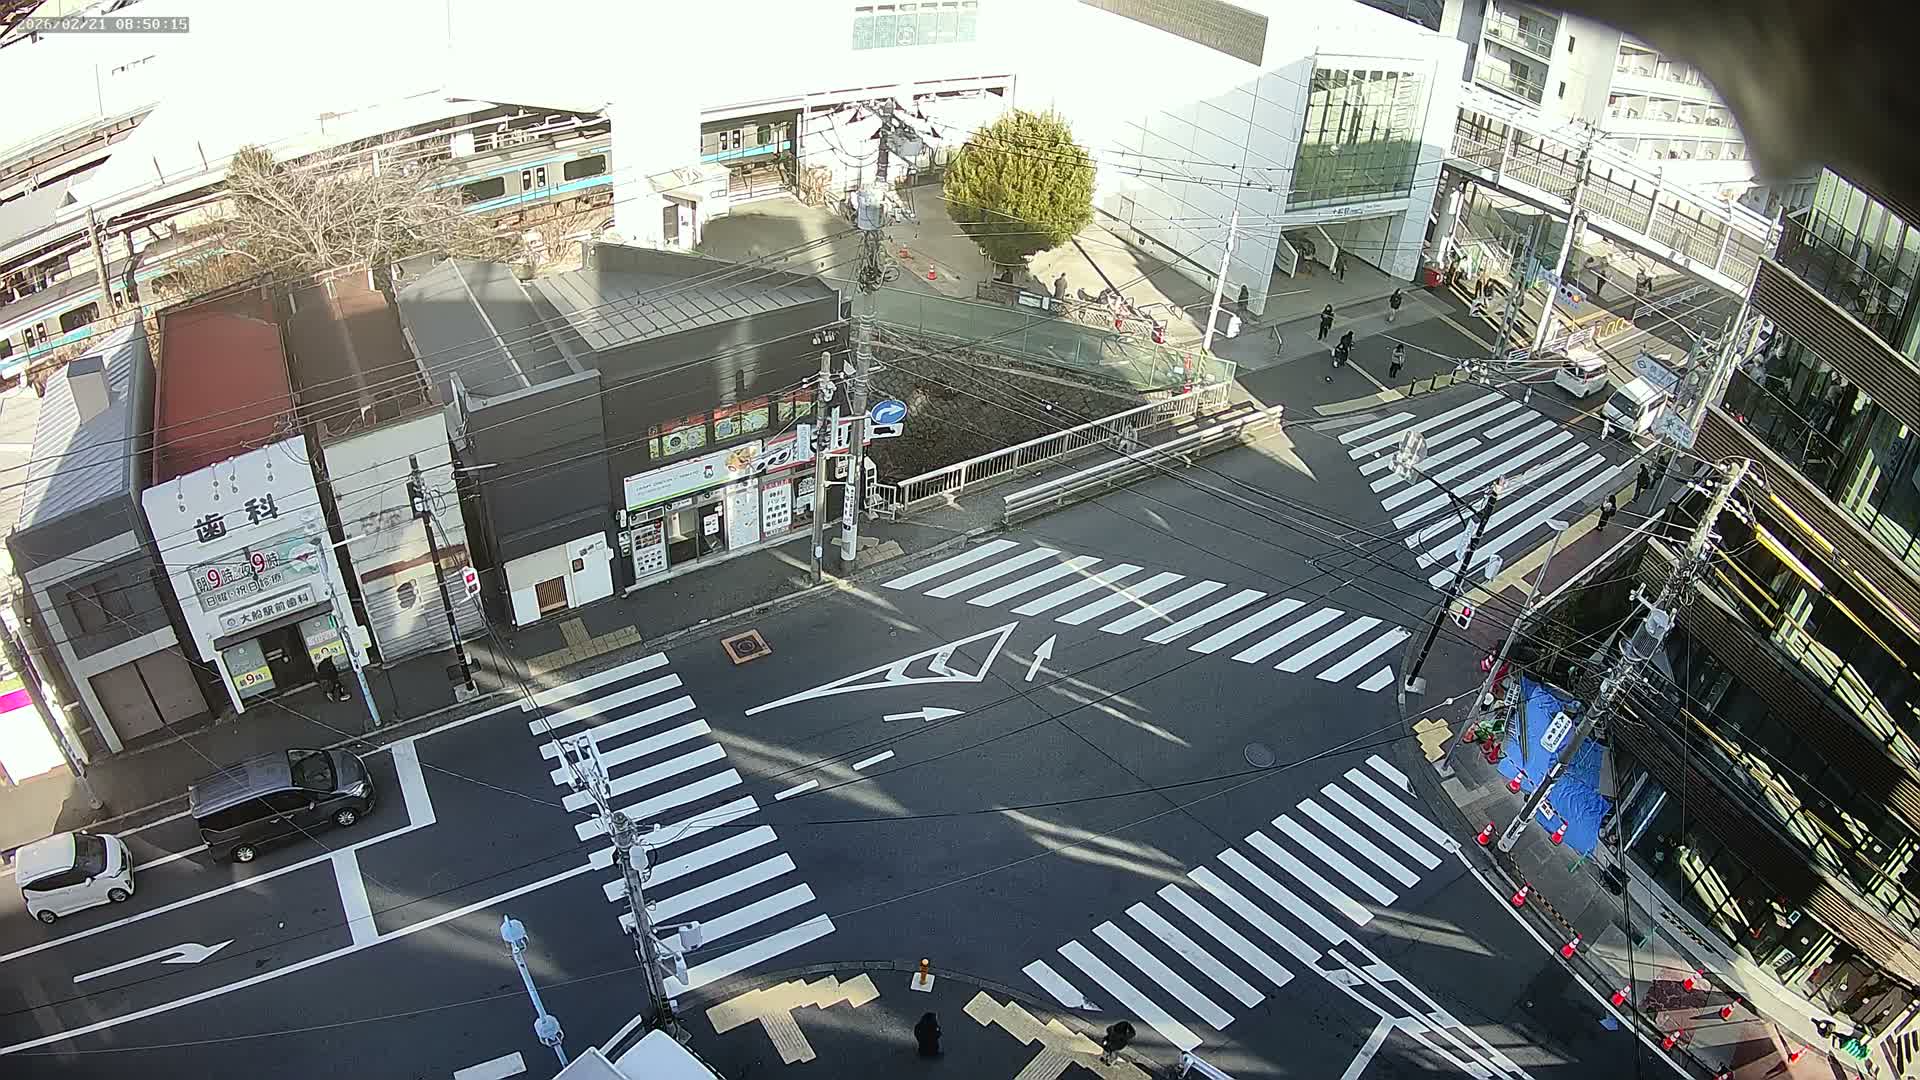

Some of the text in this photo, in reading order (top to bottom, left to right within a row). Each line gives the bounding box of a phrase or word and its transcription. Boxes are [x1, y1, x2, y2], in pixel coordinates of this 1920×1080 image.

[193, 493, 279, 543] 歯科
[241, 593, 309, 625] 大船駅前歯科
